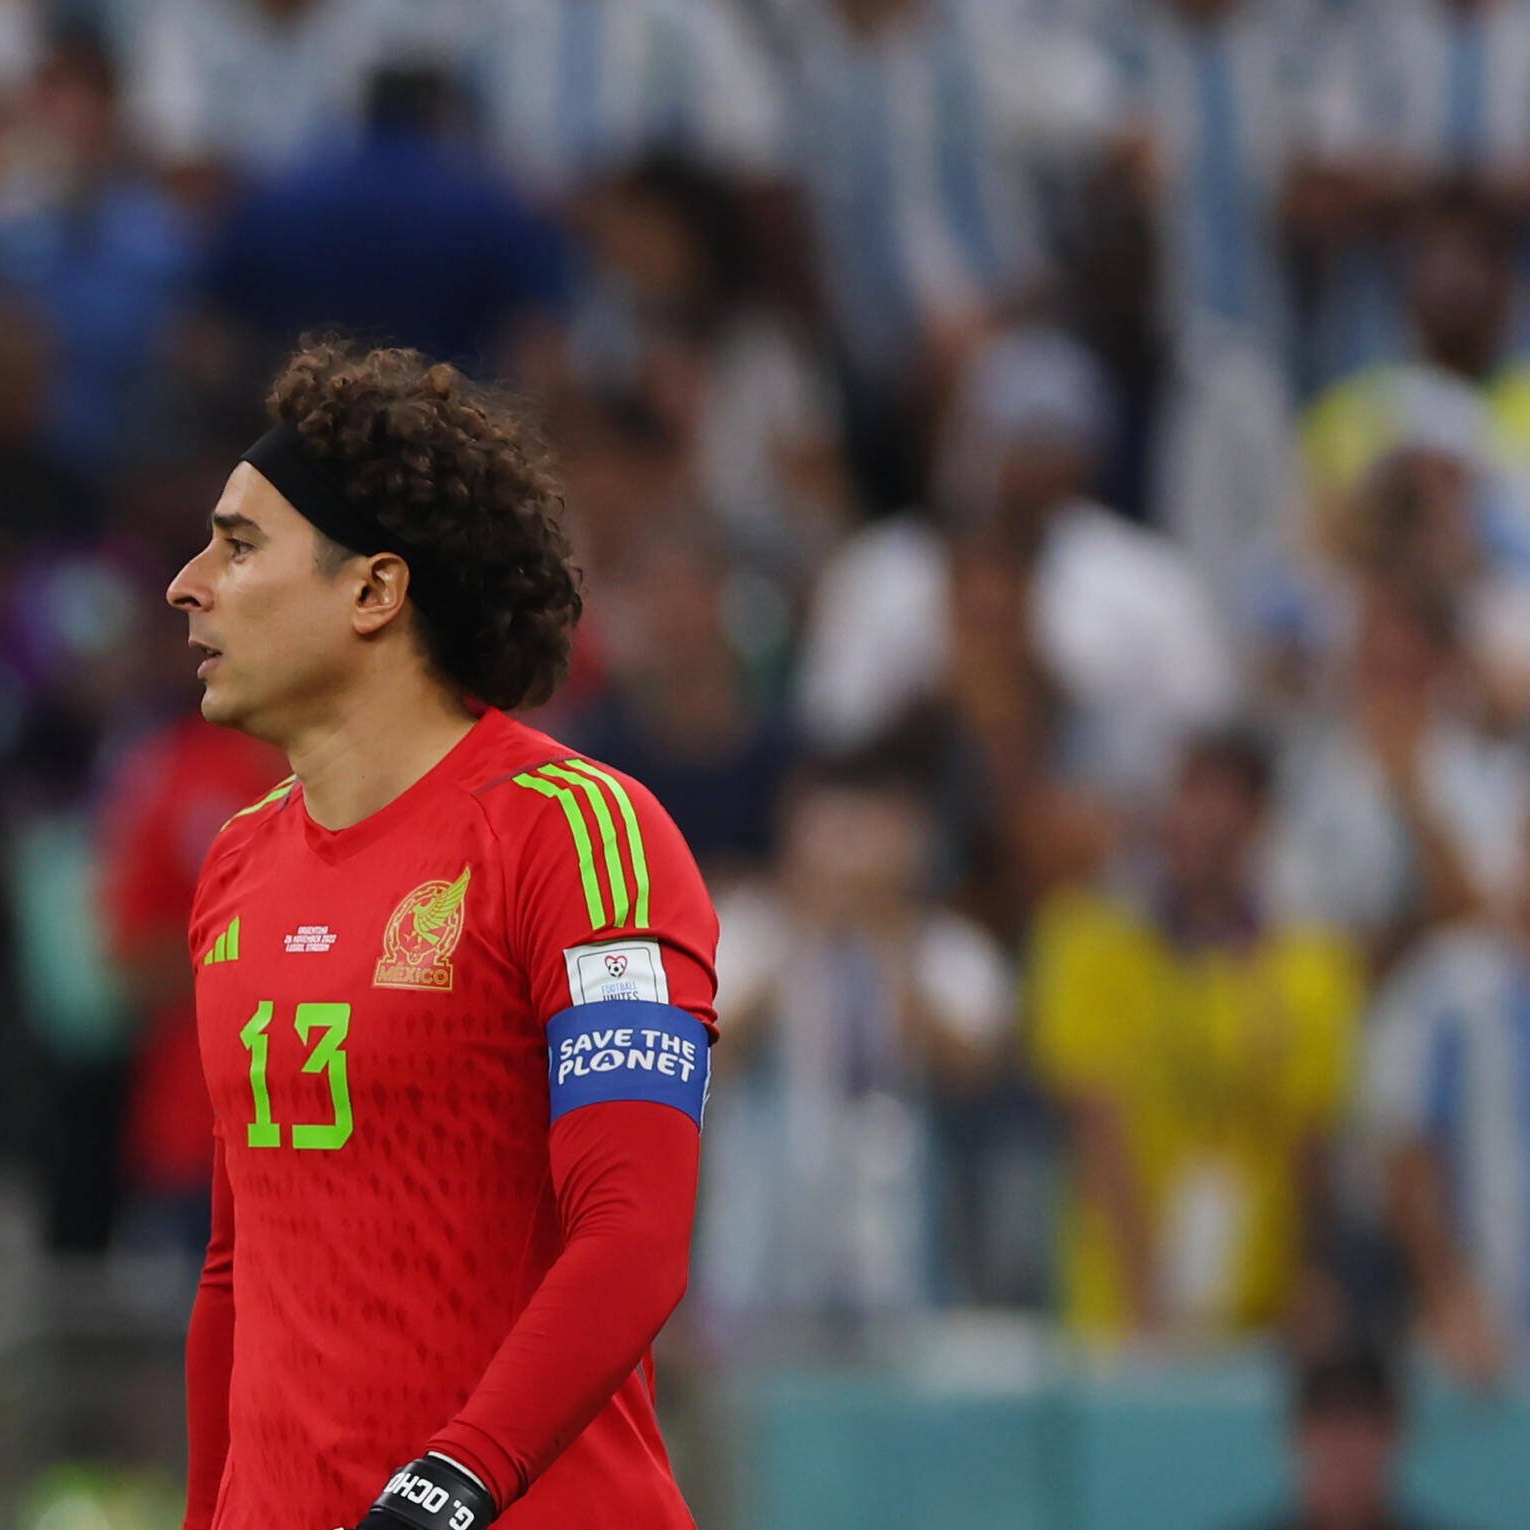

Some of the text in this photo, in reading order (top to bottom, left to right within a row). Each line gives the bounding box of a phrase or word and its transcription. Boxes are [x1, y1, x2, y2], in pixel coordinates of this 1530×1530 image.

[601, 981, 638, 994] FOOTBALL
[560, 1028, 697, 1062] SAVE THE
[240, 1001, 353, 1150] 13
[558, 1049, 695, 1085] PLANET
[383, 1471, 450, 1514] OCHO
